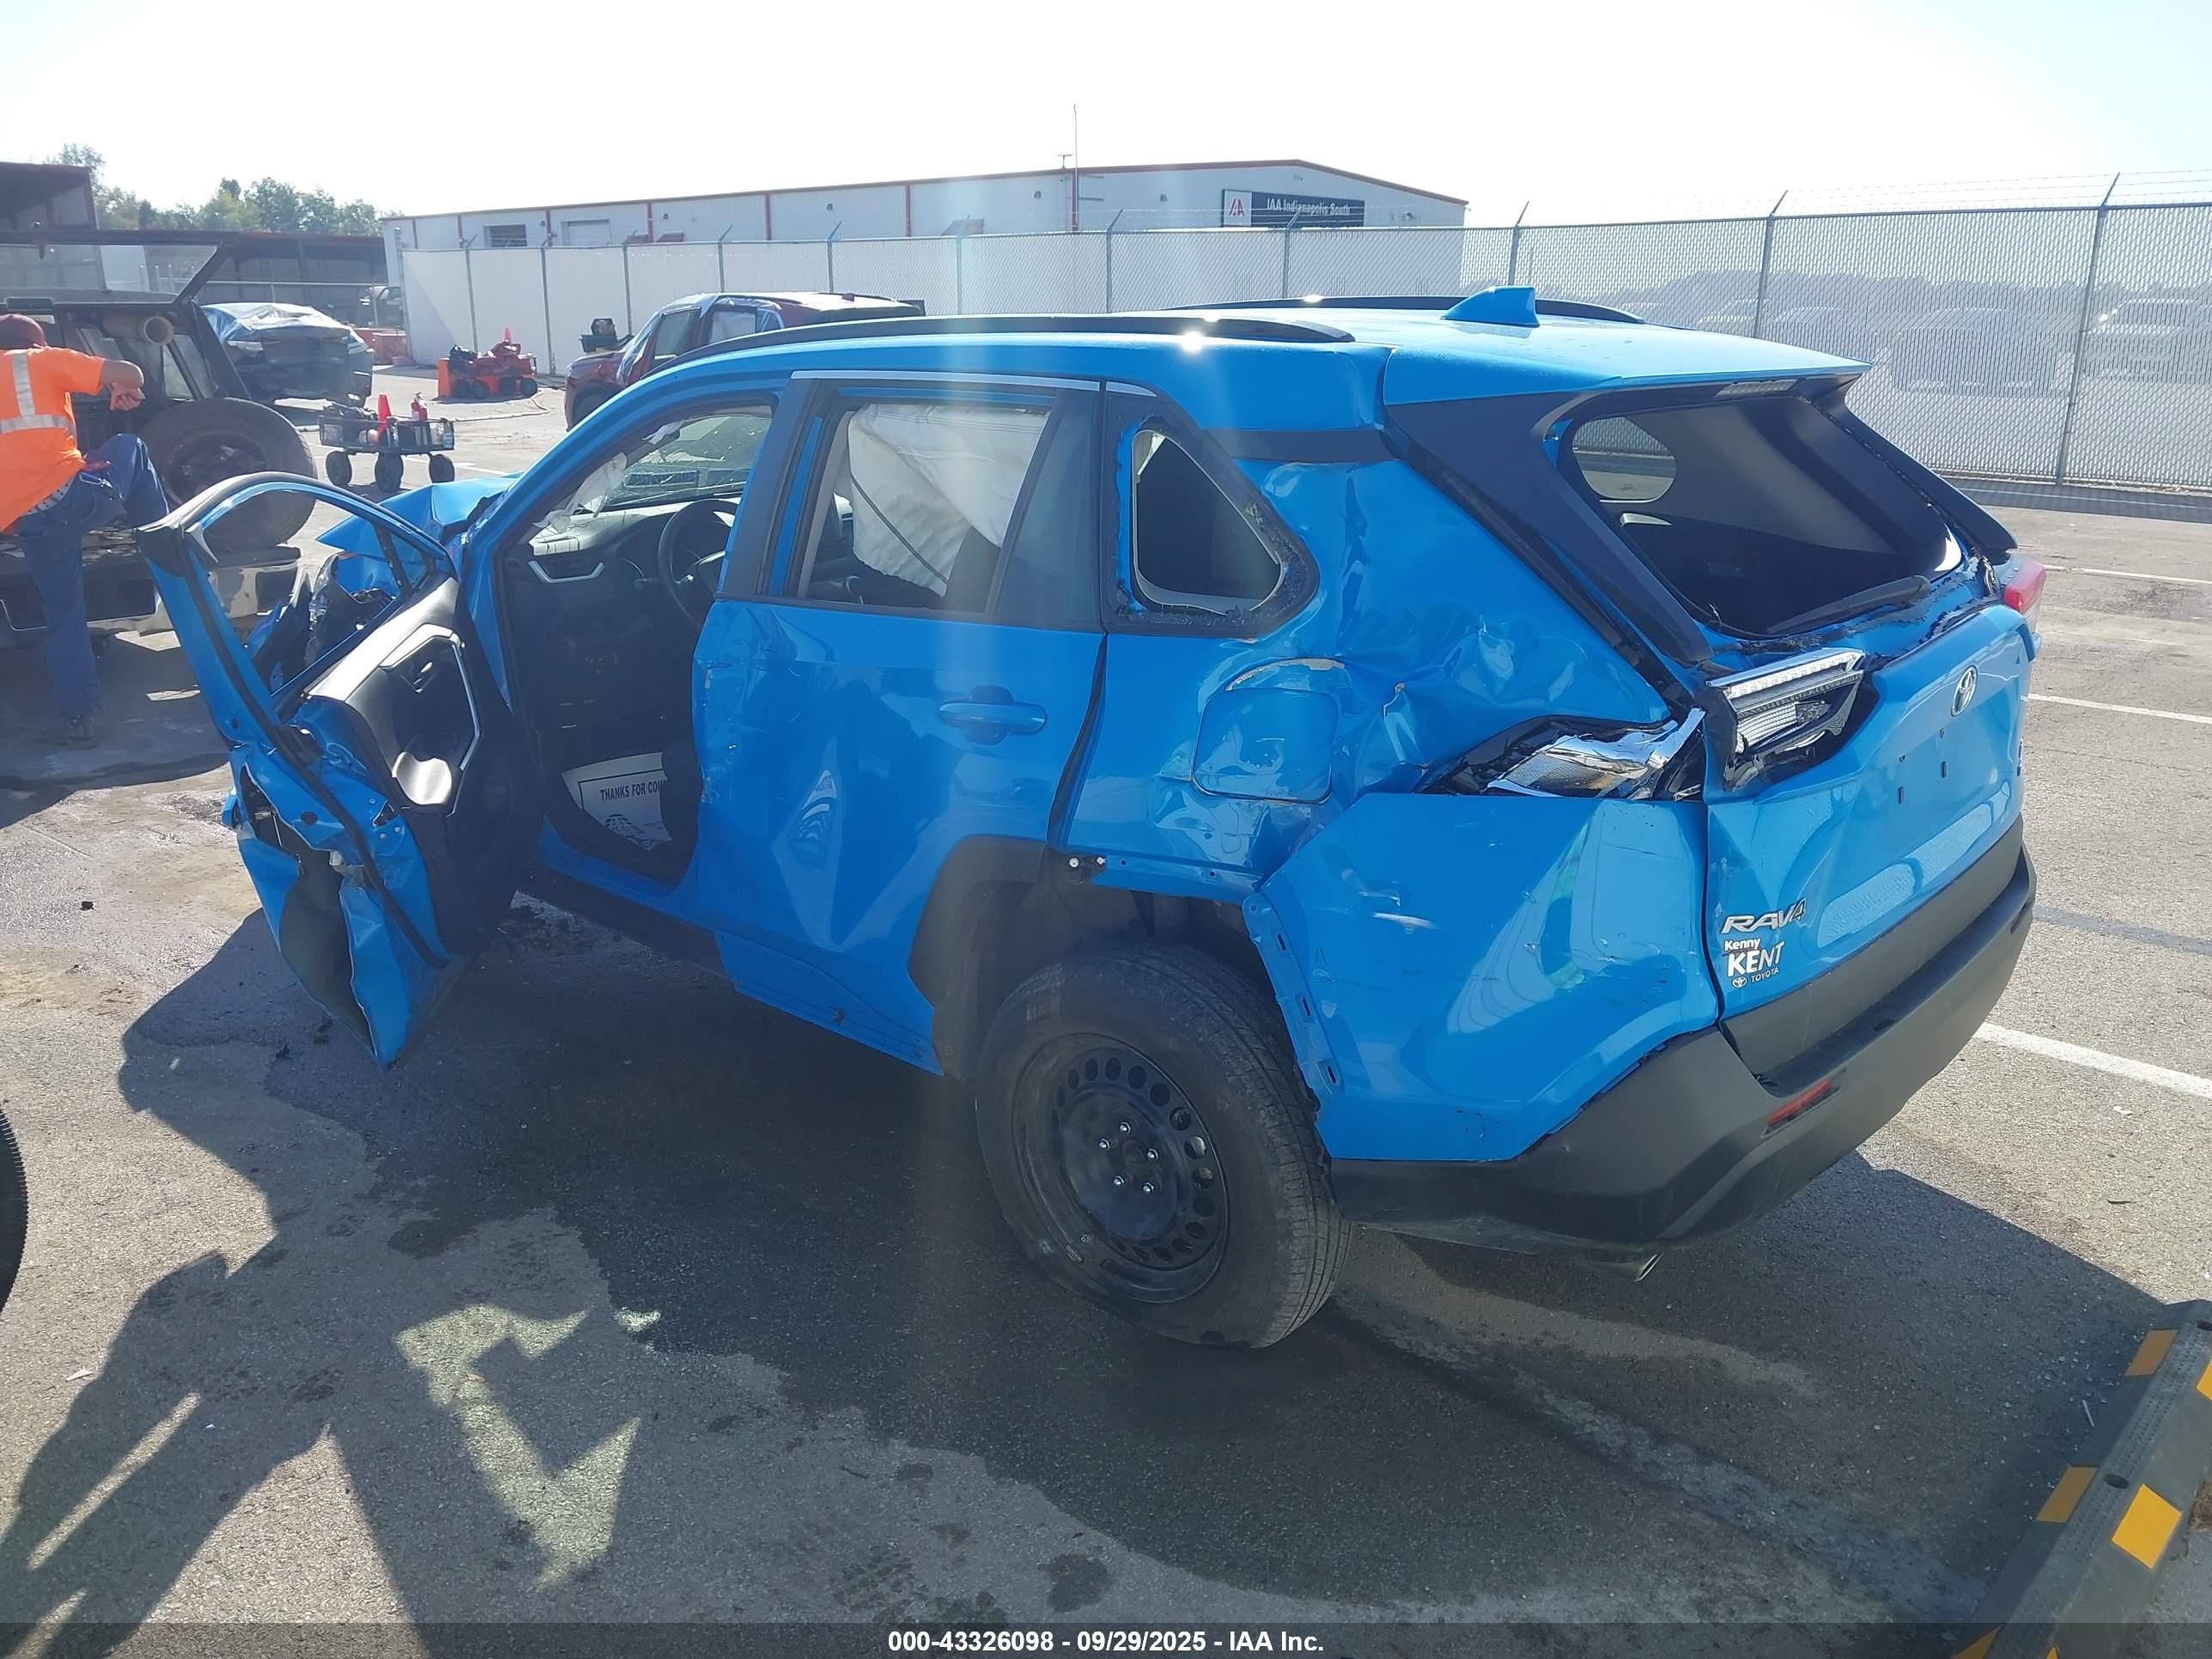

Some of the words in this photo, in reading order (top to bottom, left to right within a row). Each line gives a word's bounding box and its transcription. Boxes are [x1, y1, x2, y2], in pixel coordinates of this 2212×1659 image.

[1267, 198, 1281, 212] IAA
[1329, 202, 1351, 216] South
[600, 785, 630, 801] THANKS
[631, 783, 646, 796] FOR
[1721, 897, 1807, 934] RAV4
[1724, 938, 1761, 951] Kenny
[1727, 941, 1785, 977] KENT
[1750, 967, 1779, 983] TOYOTA
